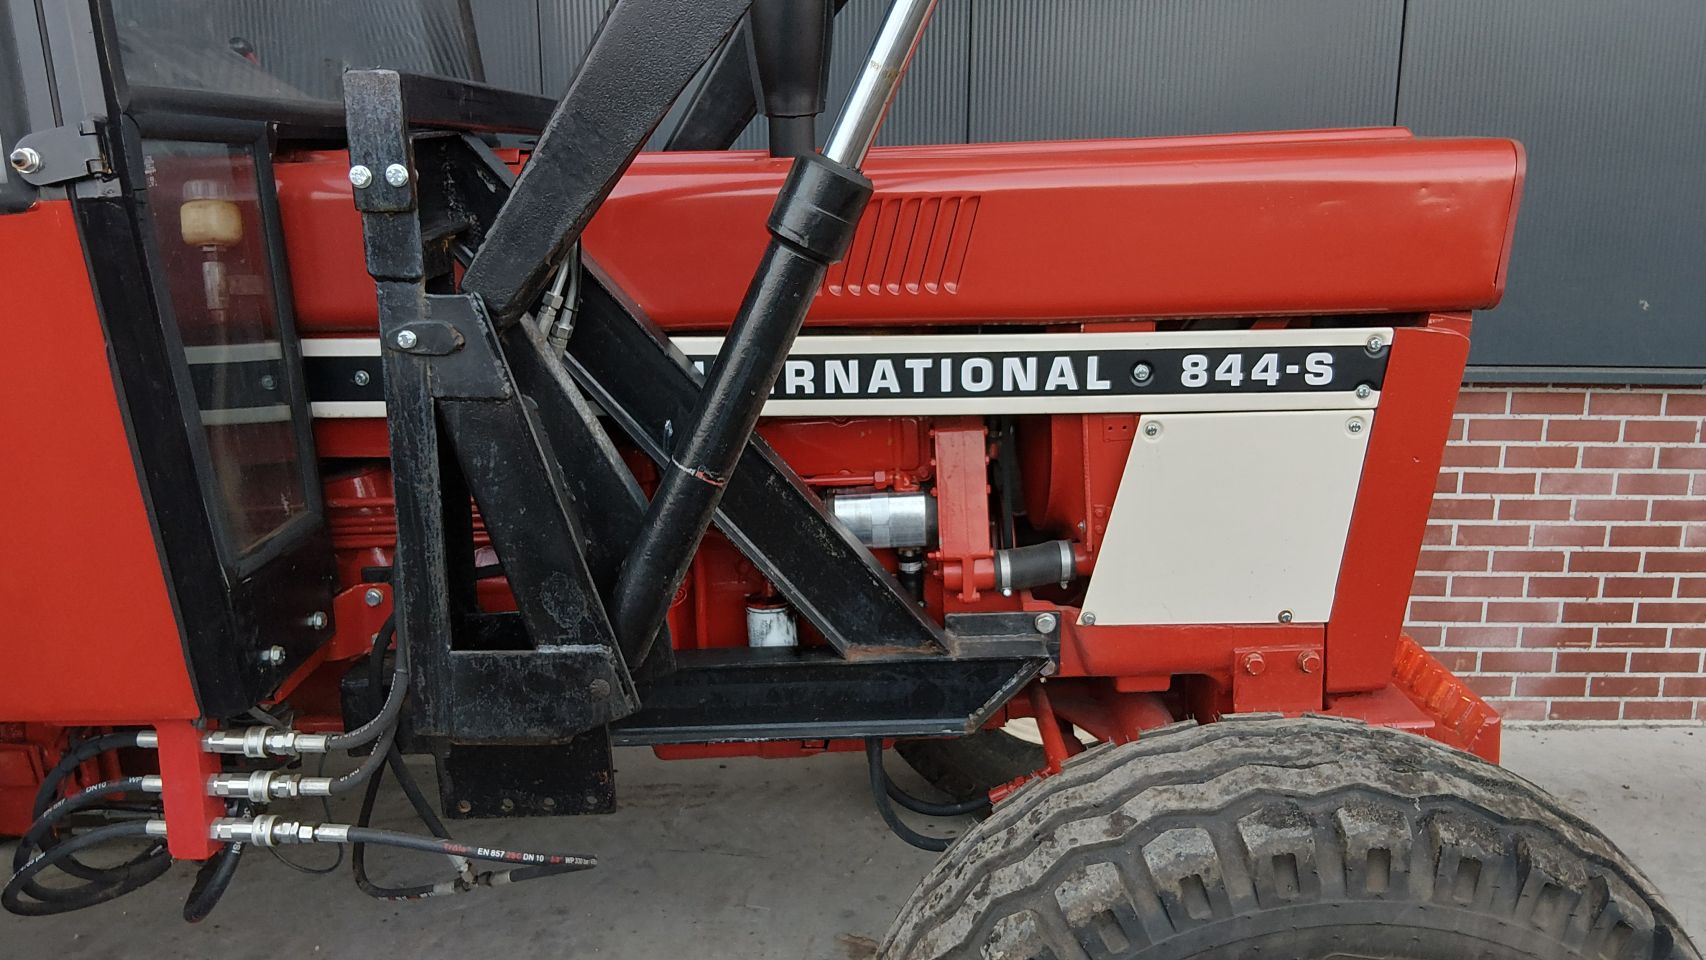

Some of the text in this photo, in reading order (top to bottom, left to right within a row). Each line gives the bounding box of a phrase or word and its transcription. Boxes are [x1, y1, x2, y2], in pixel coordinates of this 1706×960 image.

[693, 352, 1334, 394] RNATIONAL 844-S
[477, 847, 490, 857] EN
[490, 849, 506, 859] 857
[523, 853, 534, 862] DN
[536, 855, 545, 863] 10
